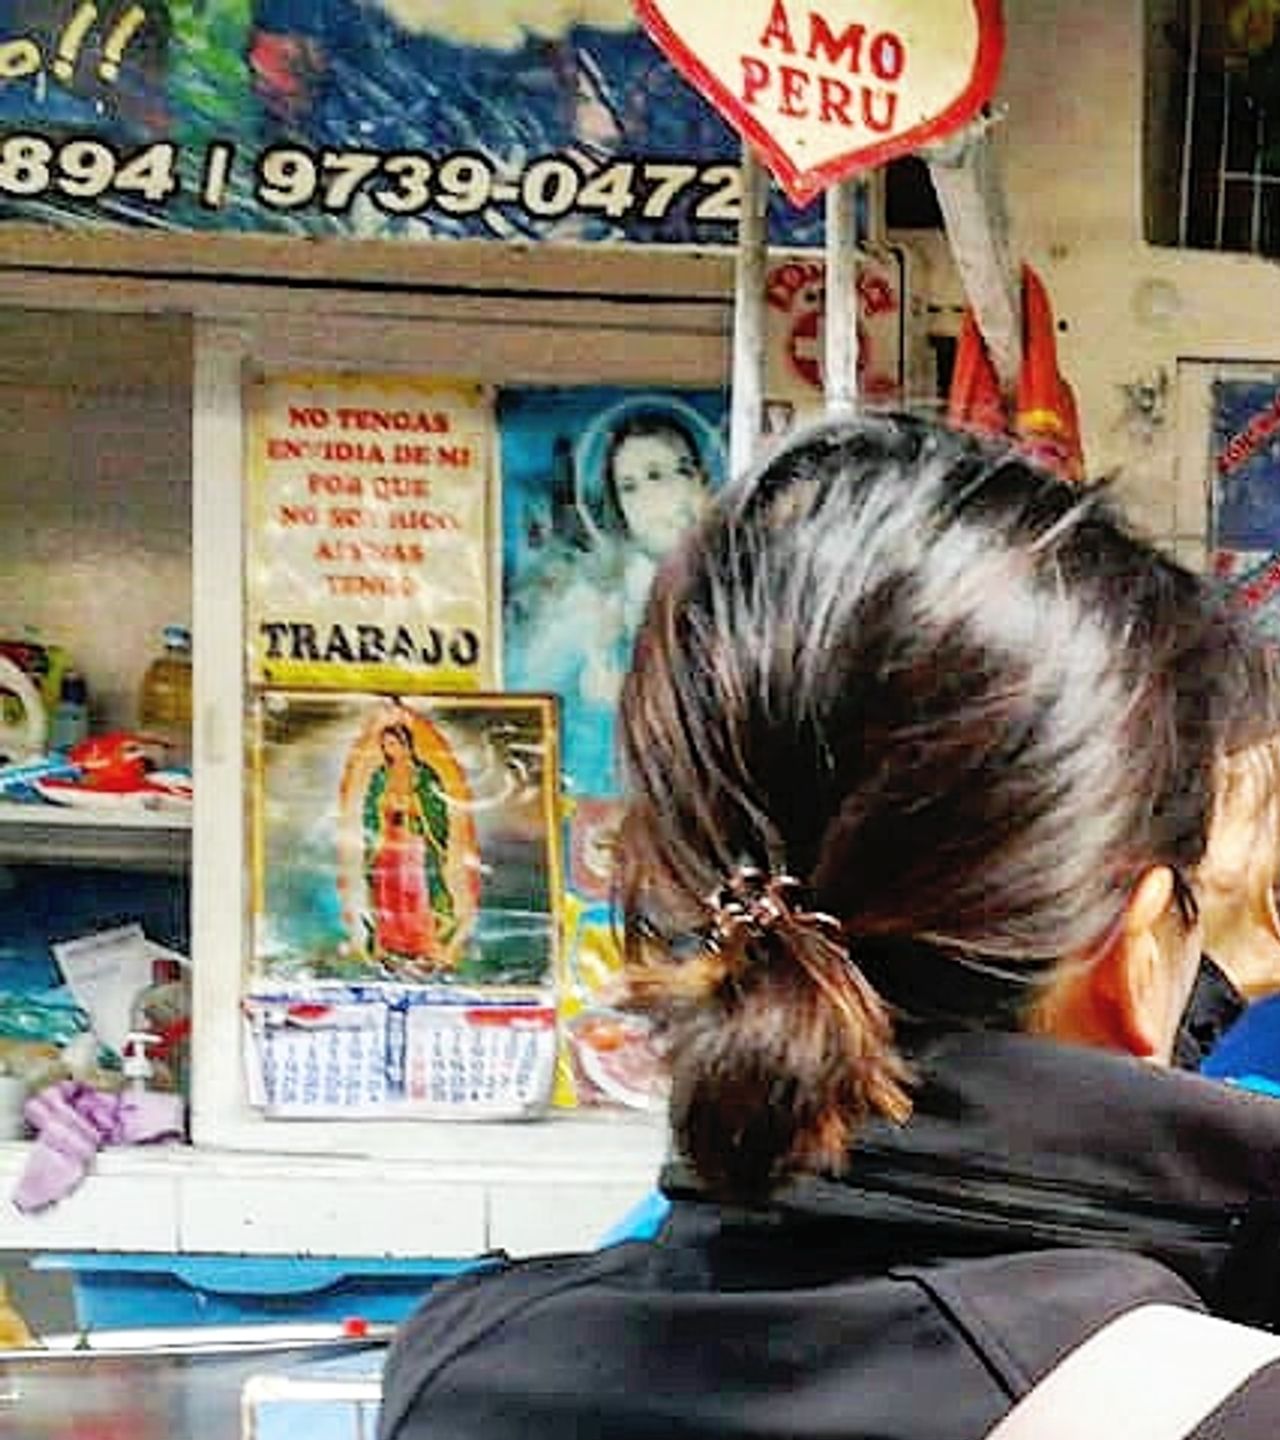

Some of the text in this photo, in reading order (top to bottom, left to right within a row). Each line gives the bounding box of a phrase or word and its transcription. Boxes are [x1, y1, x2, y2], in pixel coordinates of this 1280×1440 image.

[759, 0, 905, 81] AMO
[740, 56, 898, 133] PERU
[0, 135, 177, 200] 894
[260, 150, 743, 219] 9739-0472
[288, 406, 329, 428] NO
[326, 575, 418, 598] TENO
[260, 621, 480, 667] TRABAJO
